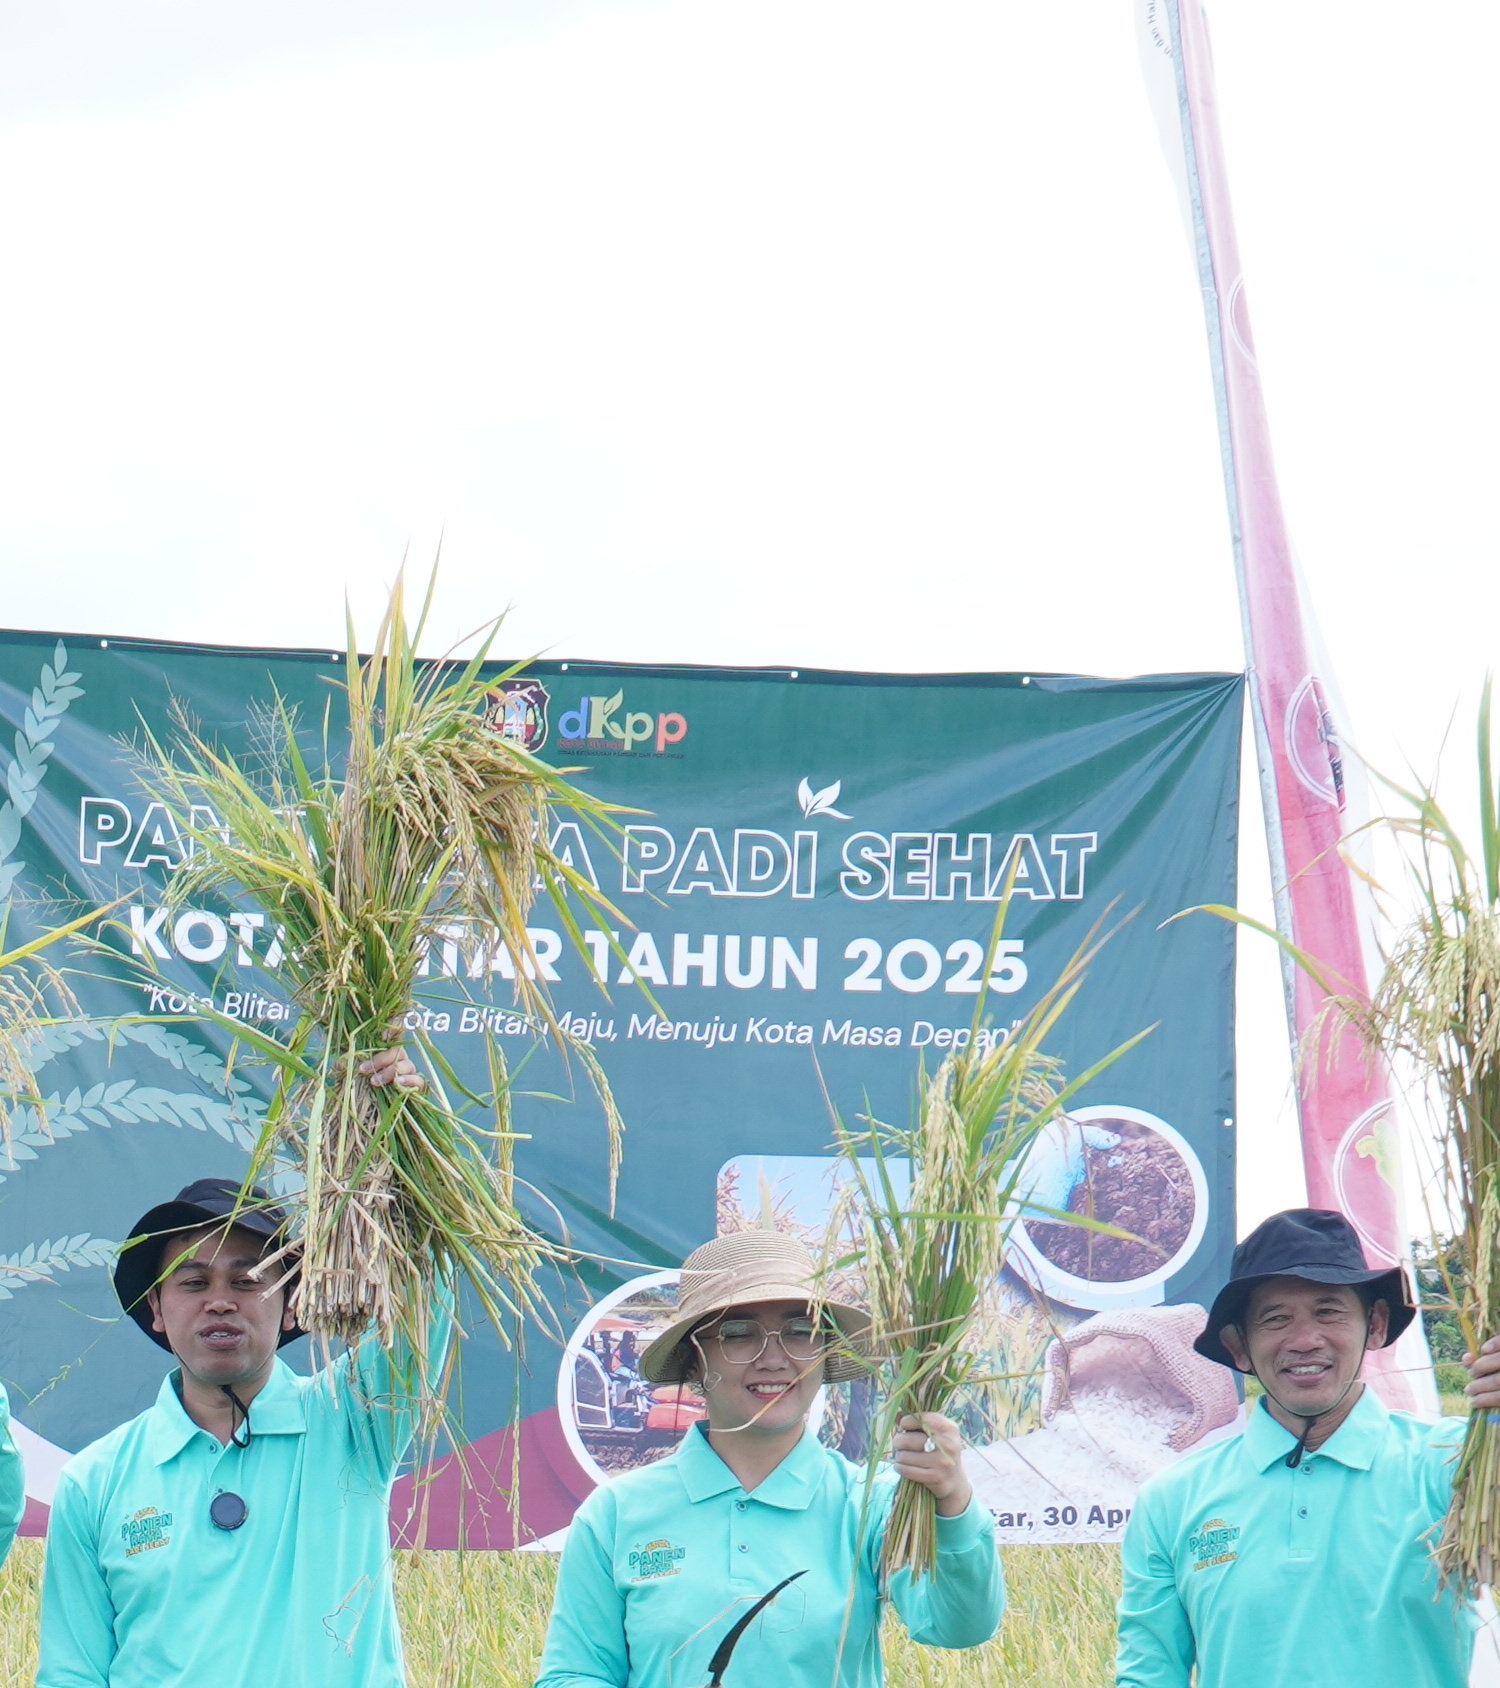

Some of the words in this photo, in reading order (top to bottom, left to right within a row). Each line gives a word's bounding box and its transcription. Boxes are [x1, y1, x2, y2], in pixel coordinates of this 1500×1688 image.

[622, 824, 818, 899] PADI
[840, 831, 1098, 901] SEHAT
[583, 929, 819, 991] TAHUN
[843, 937, 1029, 994] 2025
[628, 1013, 737, 1049] Menuju
[745, 1016, 813, 1045] Kota
[822, 1019, 902, 1047] Masa
[1043, 1505, 1078, 1527] 30
